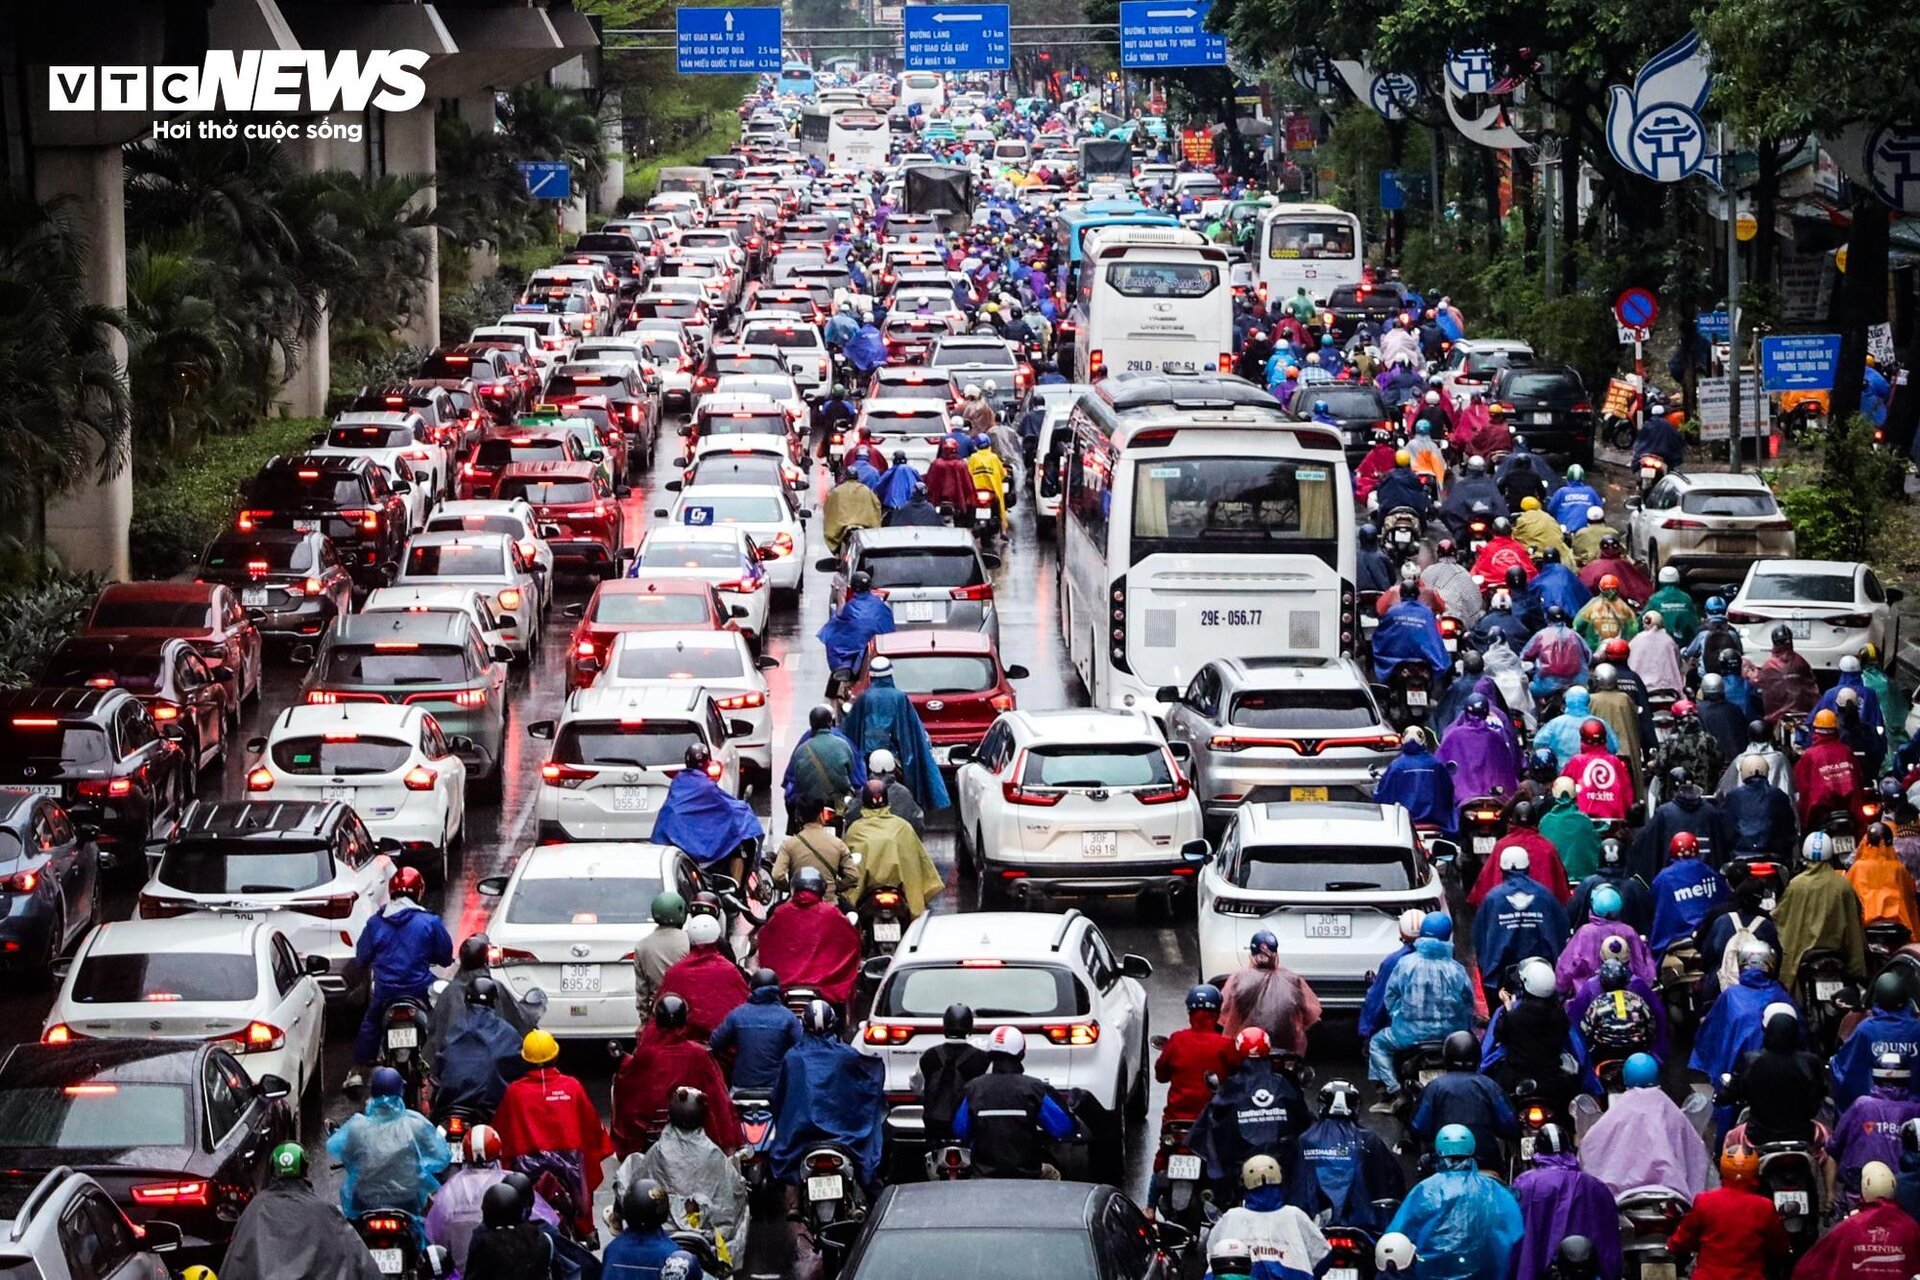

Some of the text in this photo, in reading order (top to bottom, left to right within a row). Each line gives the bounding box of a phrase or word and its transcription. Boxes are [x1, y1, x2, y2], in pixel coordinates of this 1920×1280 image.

[693, 32, 708, 41] GIAO
[993, 30, 1004, 38] km
[924, 43, 939, 52] GIAO
[993, 43, 1004, 51] km
[1138, 40, 1153, 48] GIAO
[693, 46, 708, 55] GIAO
[758, 46, 768, 54] 2.5
[769, 46, 780, 54] km
[986, 56, 993, 64] 11
[994, 56, 1005, 64] km
[1201, 610, 1219, 625] 29E
[1228, 610, 1262, 625] 056.77
[1673, 877, 1717, 902] meiji
[1312, 926, 1346, 936] 109.99
[571, 965, 591, 977] 30F
[1876, 1122, 1903, 1134] TPBa
